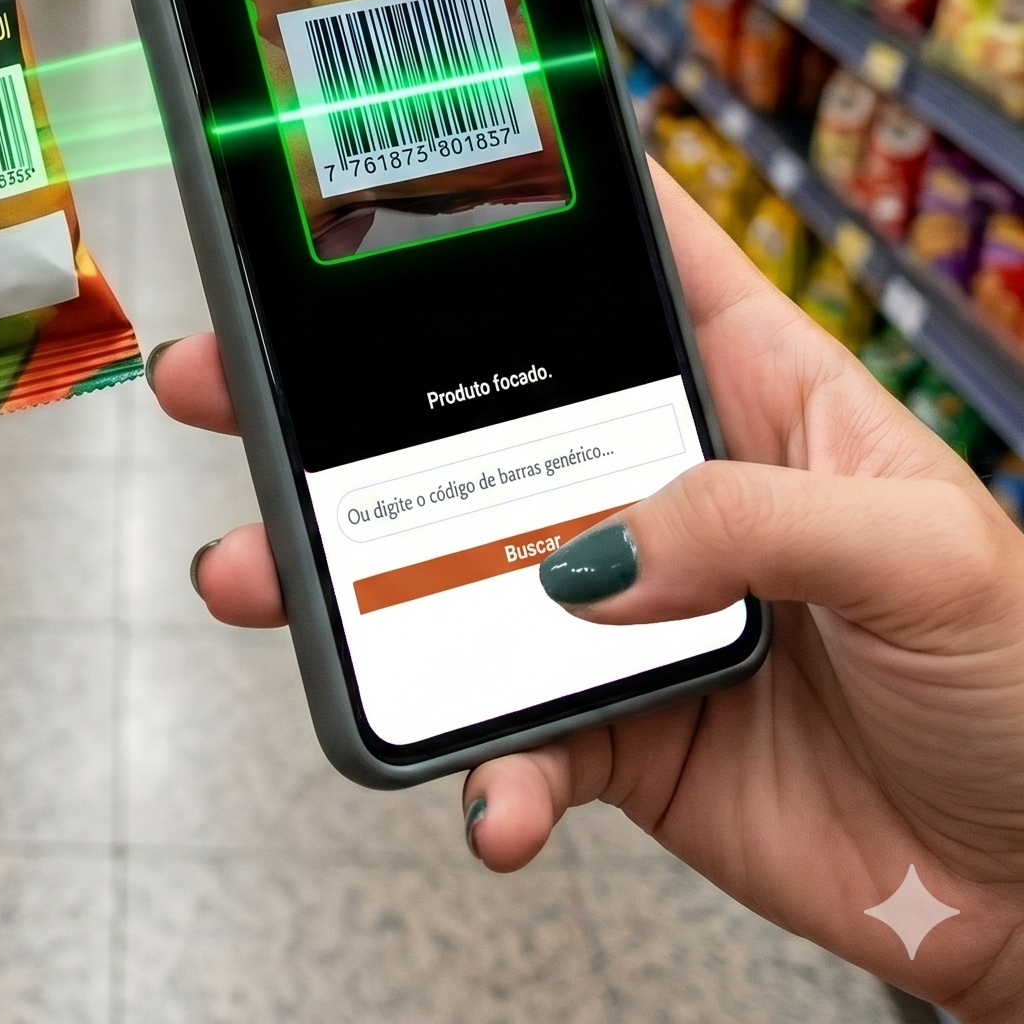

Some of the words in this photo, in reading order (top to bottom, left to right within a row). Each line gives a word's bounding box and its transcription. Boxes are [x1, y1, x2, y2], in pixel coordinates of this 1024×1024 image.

[427, 379, 491, 409] Produto
[493, 364, 553, 392] focado.
[347, 506, 371, 526] Ou
[374, 493, 413, 521] digite
[416, 494, 426, 507] o
[429, 476, 476, 505] código
[479, 471, 497, 489] de
[498, 463, 542, 486] barras
[545, 444, 615, 476] genérico...
[504, 533, 561, 563] Buscar
